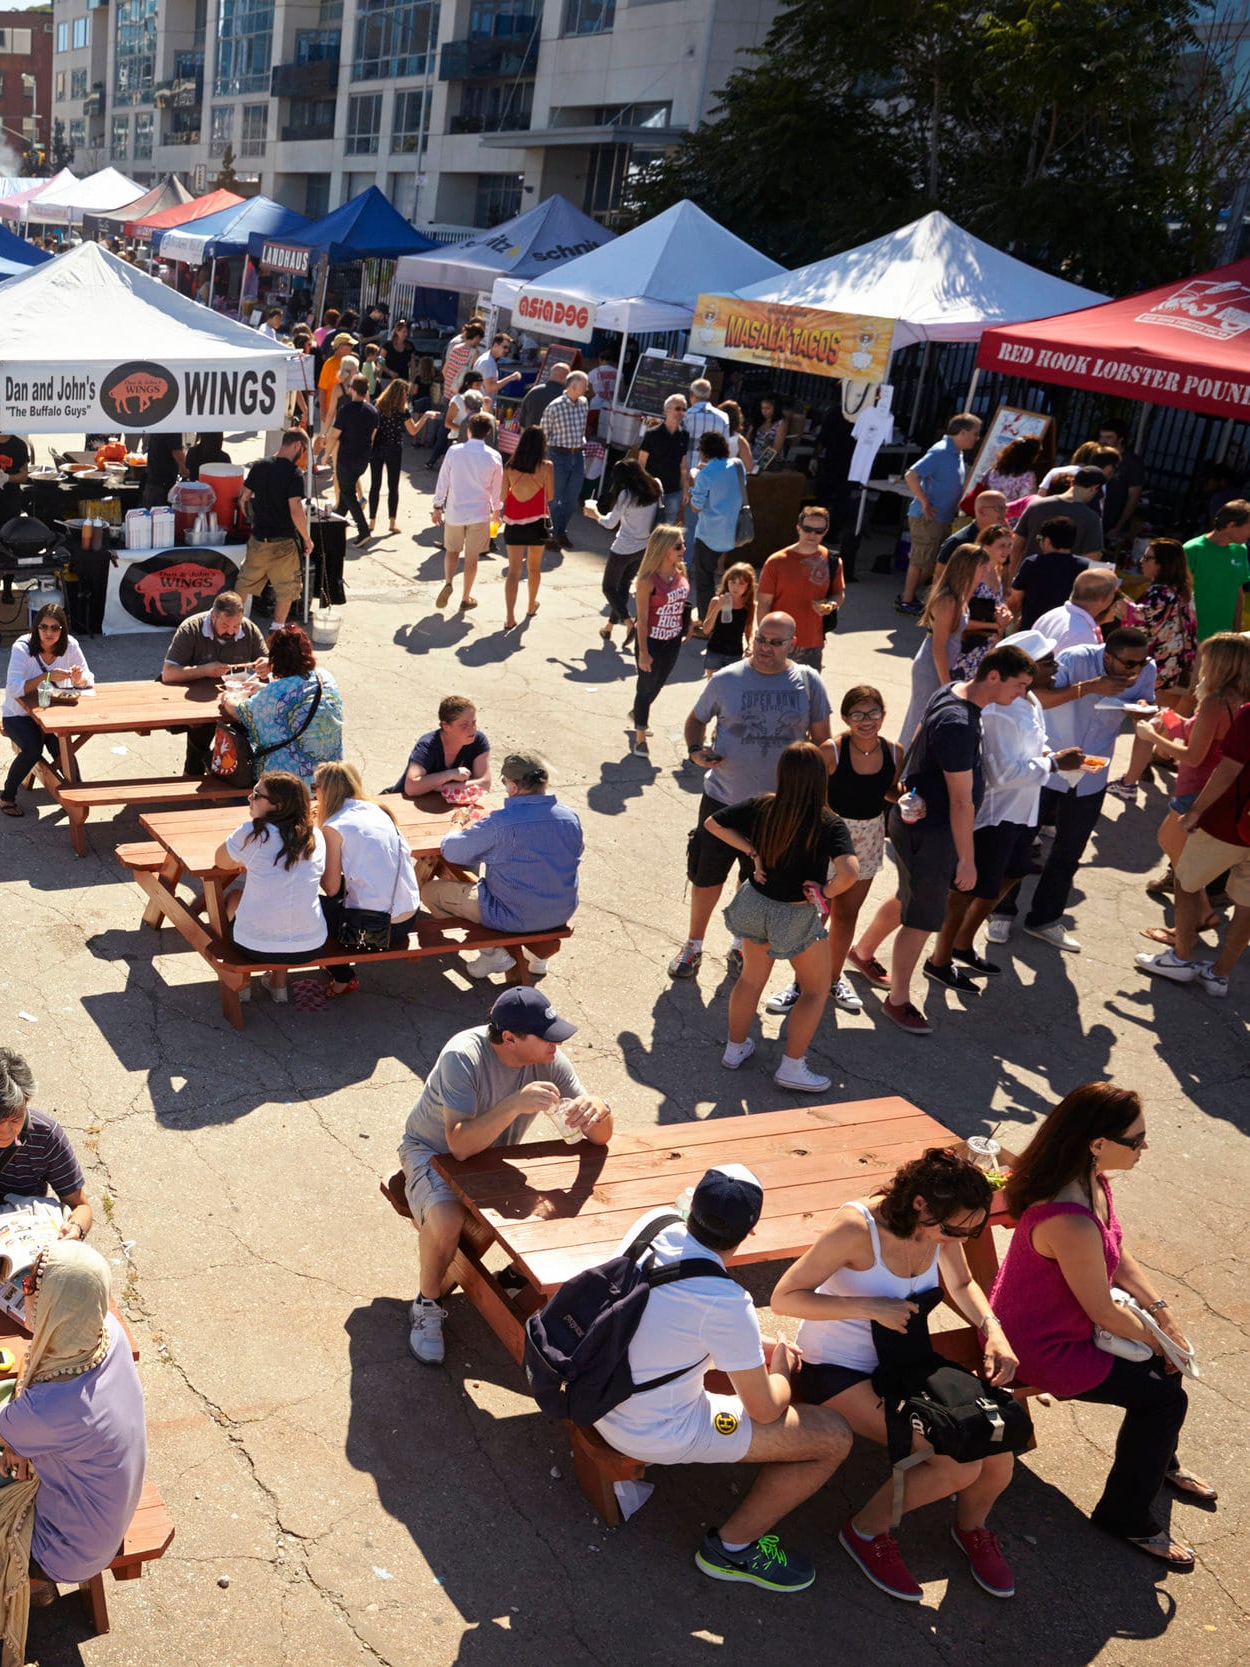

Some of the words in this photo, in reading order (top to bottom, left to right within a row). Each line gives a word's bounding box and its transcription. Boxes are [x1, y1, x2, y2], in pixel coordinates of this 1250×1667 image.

[261, 244, 309, 272] LANDHAUS
[724, 314, 786, 353] MASALA
[790, 327, 842, 366] TACOS
[998, 342, 1034, 365] RED
[1035, 349, 1092, 375] HOOK
[1091, 358, 1181, 393] LOBSTER
[5, 375, 29, 402] Dan
[32, 376, 54, 401] and
[57, 375, 96, 401] John's
[126, 385, 160, 394] WINGS
[184, 369, 277, 416] WINGS
[5, 406, 27, 418] "The
[29, 405, 62, 417] Buffalo
[64, 404, 92, 419] Guys"
[160, 576, 214, 588] WINGS
[741, 693, 771, 712] SUPER
[775, 693, 802, 712] BOWL
